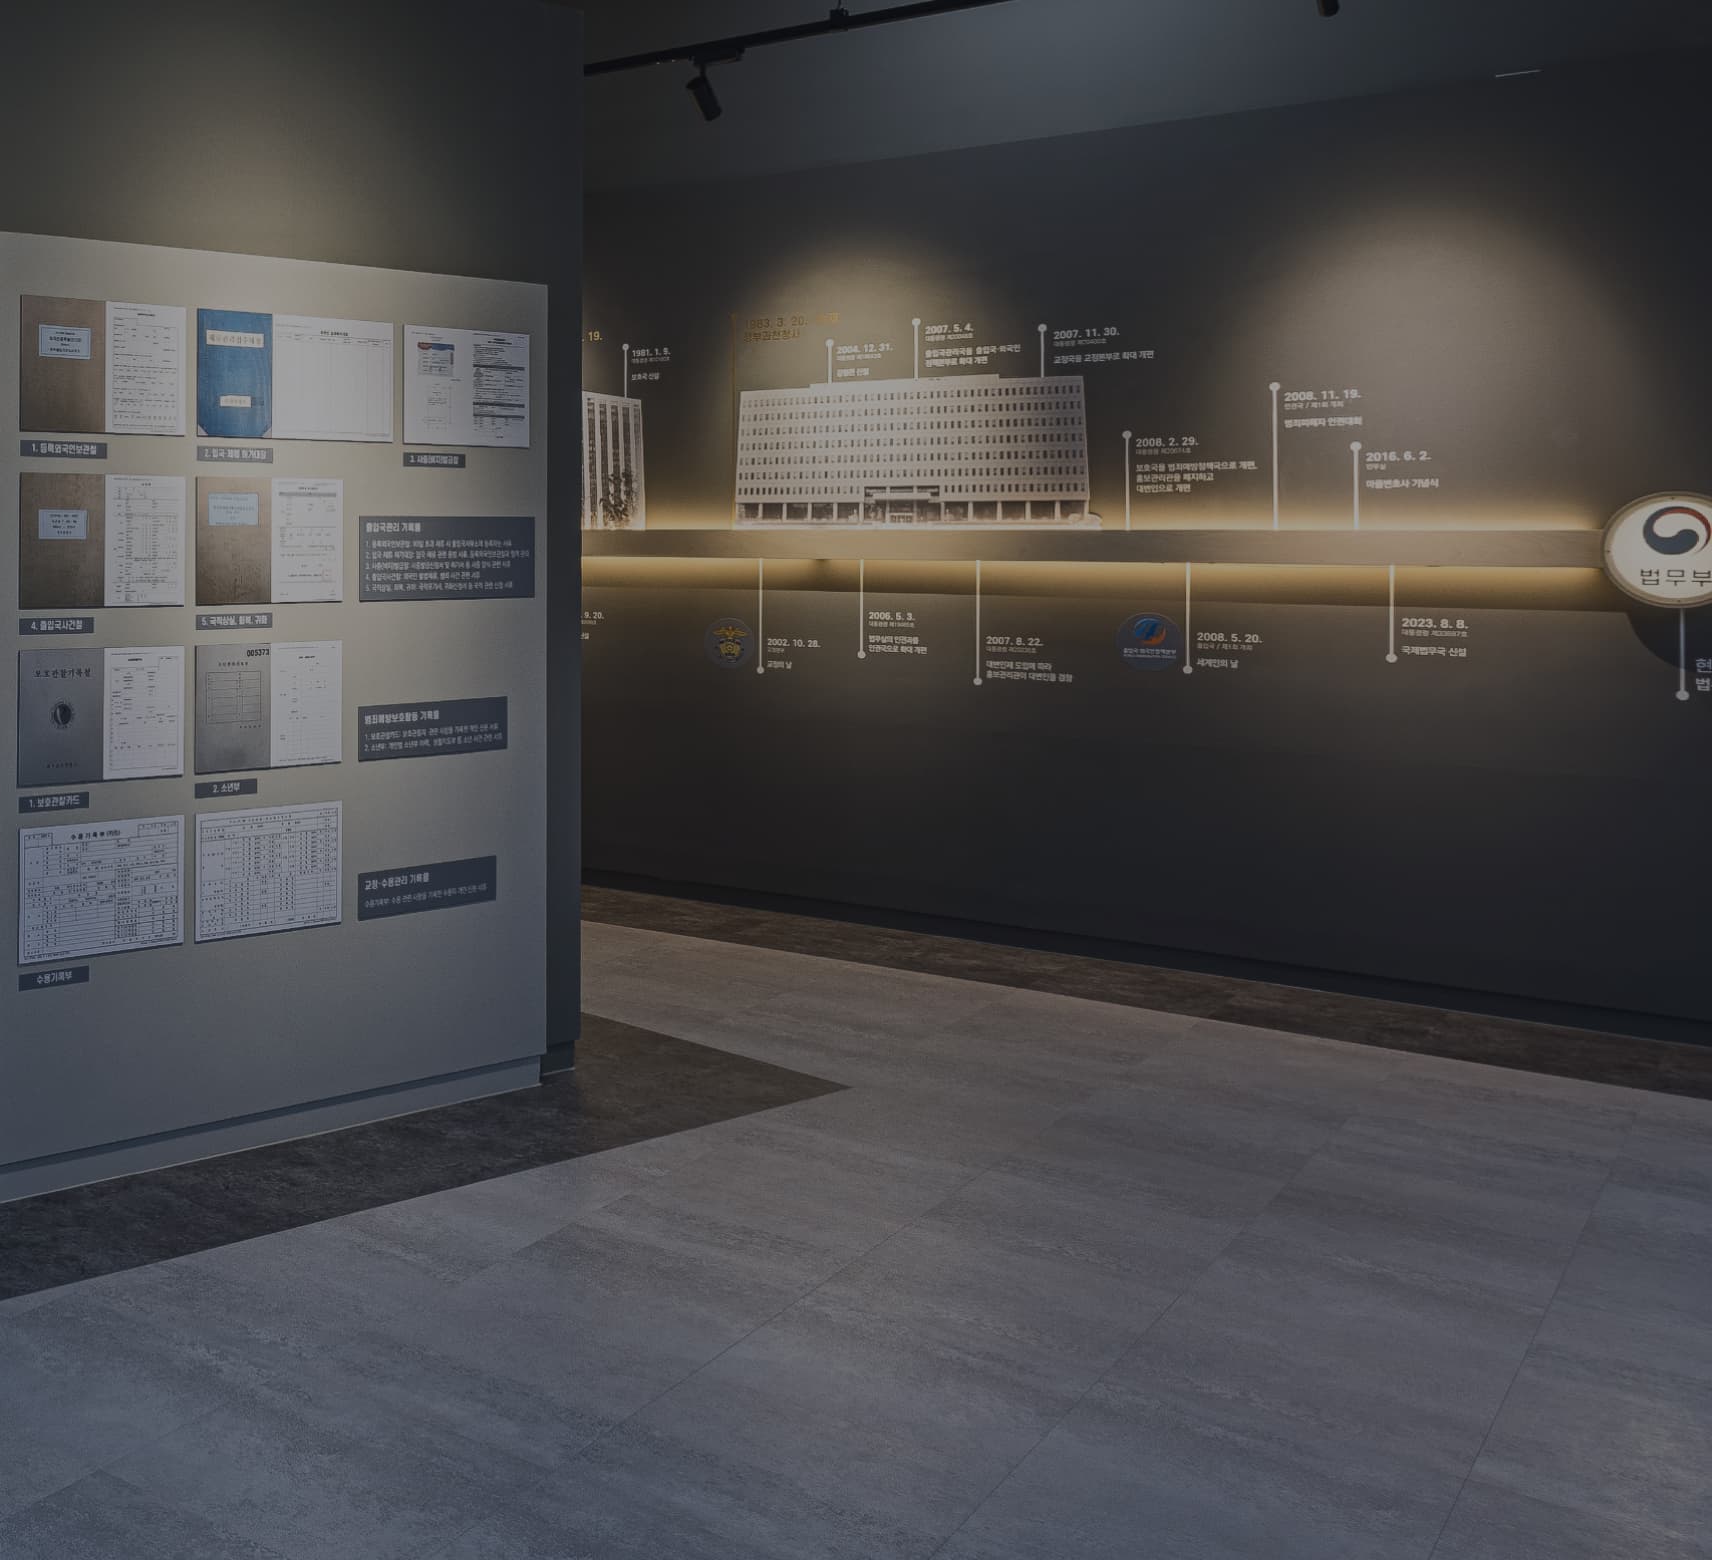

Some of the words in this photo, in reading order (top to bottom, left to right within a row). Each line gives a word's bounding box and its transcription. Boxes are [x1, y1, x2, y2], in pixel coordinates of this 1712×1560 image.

[925, 324, 952, 335] 2007.
[952, 323, 963, 333] 5.
[964, 322, 974, 332] 4.
[1053, 329, 1082, 340] 2007.
[1084, 328, 1101, 337] 11.
[1103, 326, 1120, 336] 30.
[1284, 391, 1317, 402] 2008.
[1321, 390, 1339, 400] 11.
[1343, 389, 1361, 399] 19.
[31, 442, 39, 453] 1.
[1135, 437, 1166, 448] 2008.
[1168, 437, 1179, 447] 2.
[1181, 436, 1200, 446] 29.
[1365, 451, 1401, 462] 2016.
[1419, 450, 1432, 461] 2.
[1640, 568, 1712, 587] 법무부
[31, 621, 39, 631] 4.
[201, 617, 209, 626] 5.
[1401, 617, 1437, 628] 2023.
[1439, 618, 1454, 629] 8.
[1455, 619, 1470, 630] 8.
[793, 639, 806, 648] 10.
[986, 635, 1014, 646] 2007.
[1015, 637, 1026, 646] 8.
[1027, 637, 1044, 647] 22.
[1196, 632, 1228, 642] 2008.
[1230, 633, 1241, 643] 5.
[1244, 633, 1263, 644] 20.
[246, 648, 270, 657] 005373
[1695, 677, 1712, 692] 법
[212, 784, 219, 793] 2.
[28, 798, 36, 809] 1.
